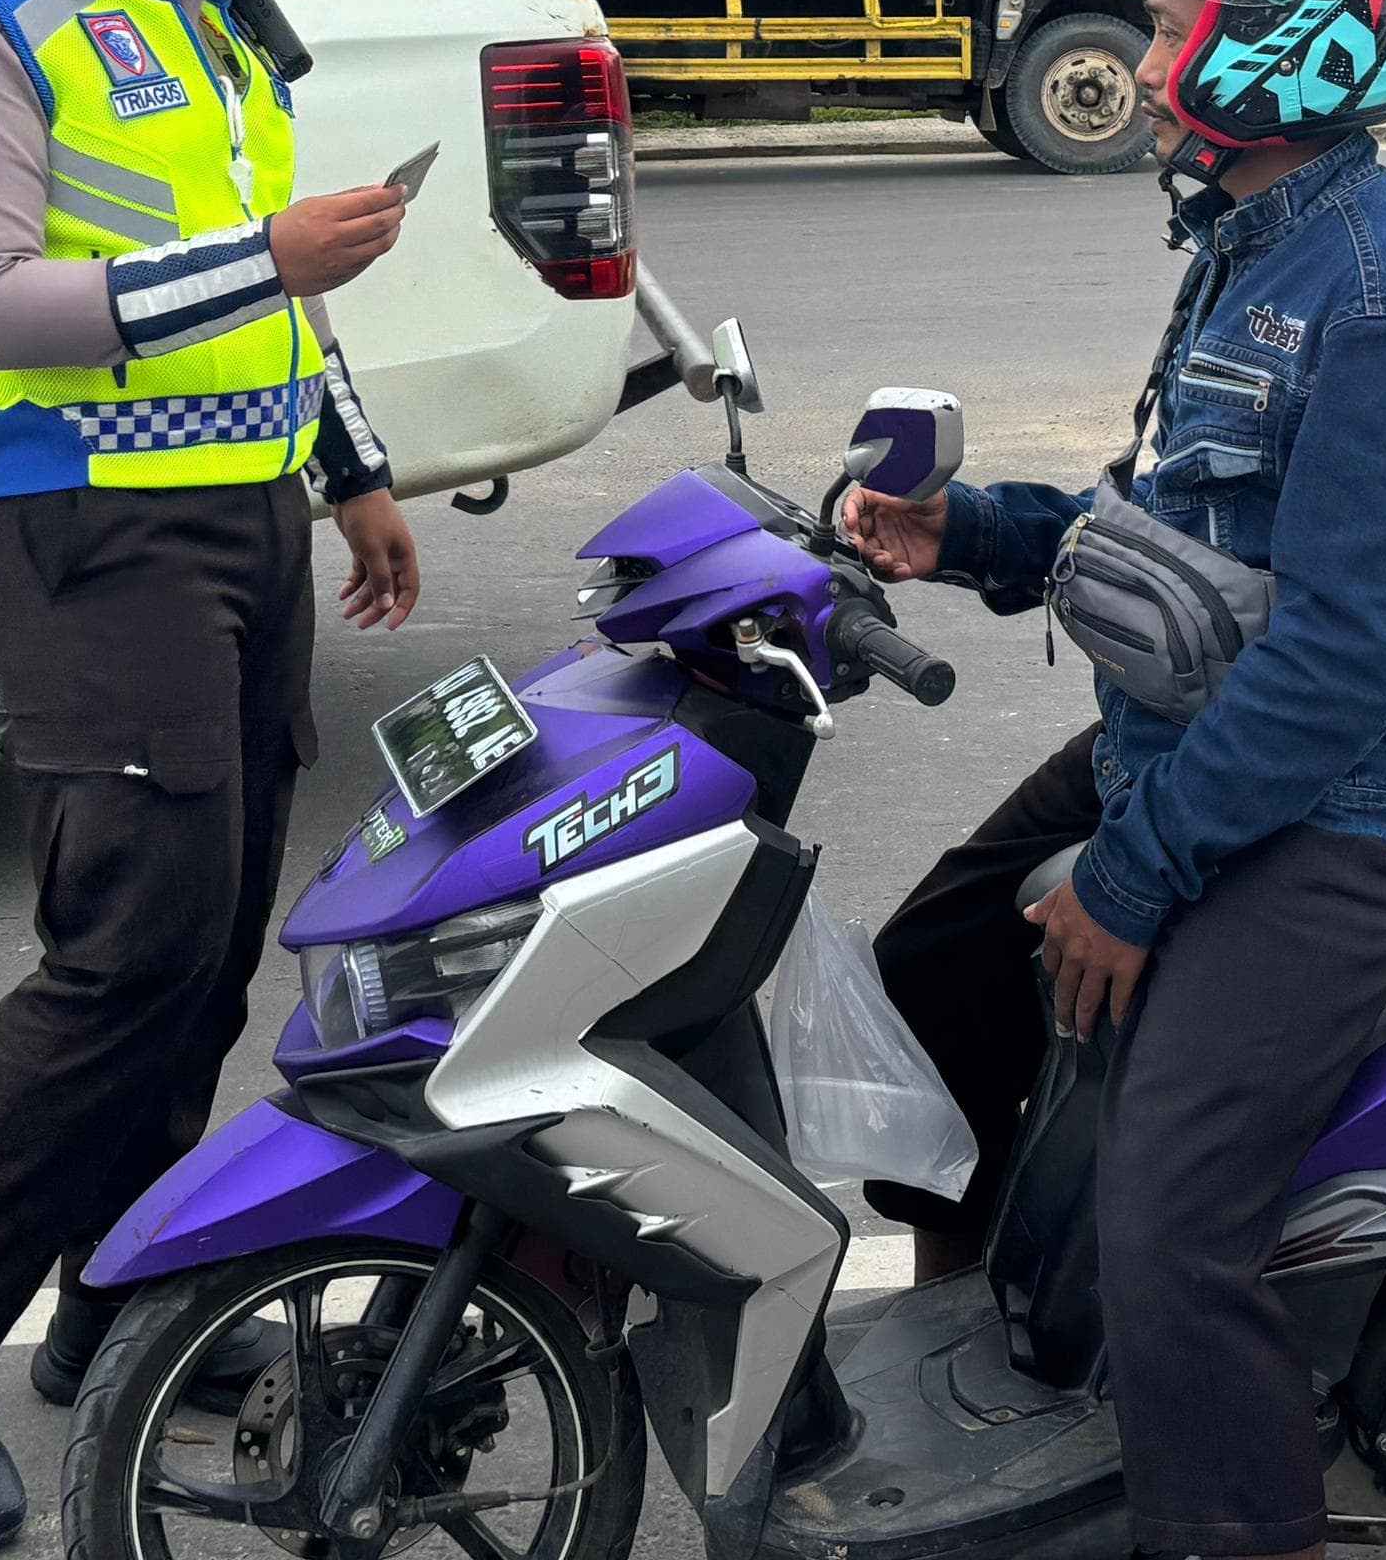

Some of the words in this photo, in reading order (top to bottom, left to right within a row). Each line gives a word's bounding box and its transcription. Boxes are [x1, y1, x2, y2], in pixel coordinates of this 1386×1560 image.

[115, 83, 183, 114] TRIAGUS
[466, 723, 525, 770] AE
[527, 750, 675, 868] TECH3
